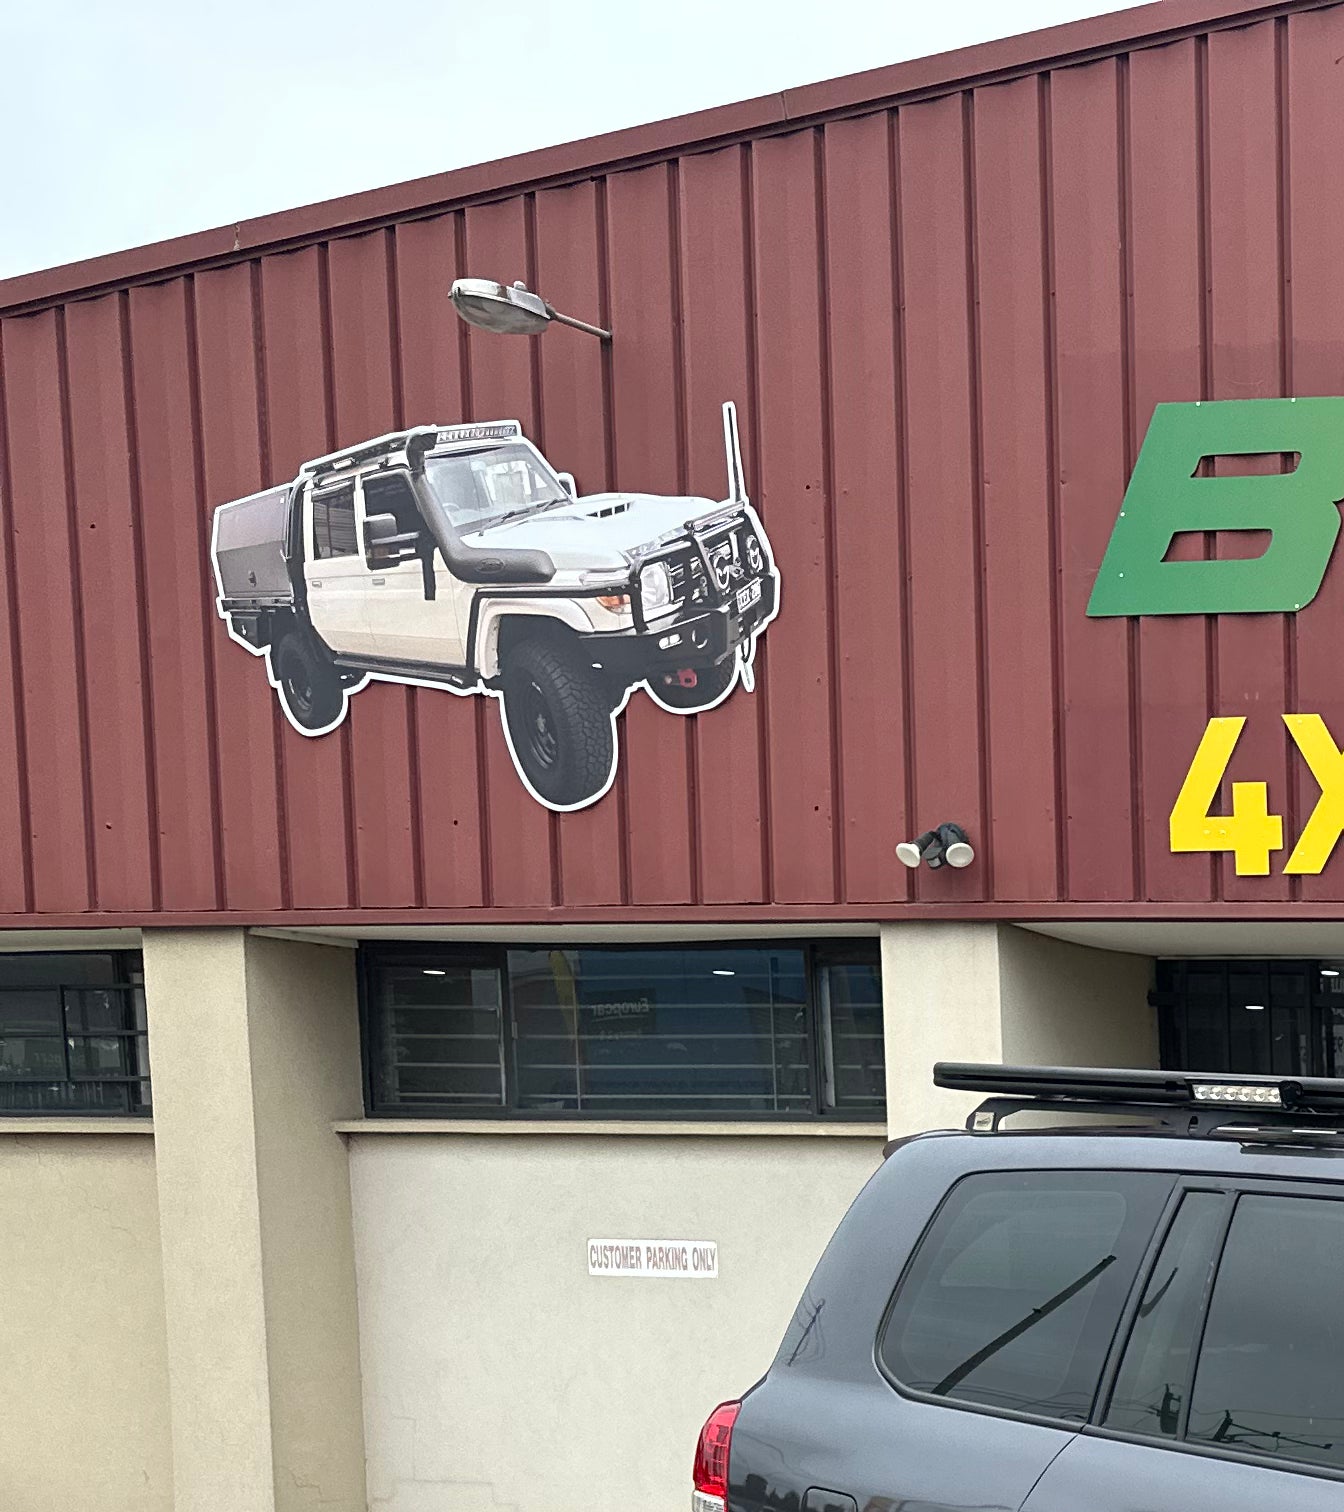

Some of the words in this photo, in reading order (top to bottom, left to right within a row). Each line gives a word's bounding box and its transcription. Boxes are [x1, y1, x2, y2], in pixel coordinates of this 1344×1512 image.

[590, 1244, 642, 1269] CUSTOMER
[646, 1246, 688, 1270] PARKING
[692, 1246, 717, 1271] ONLY
